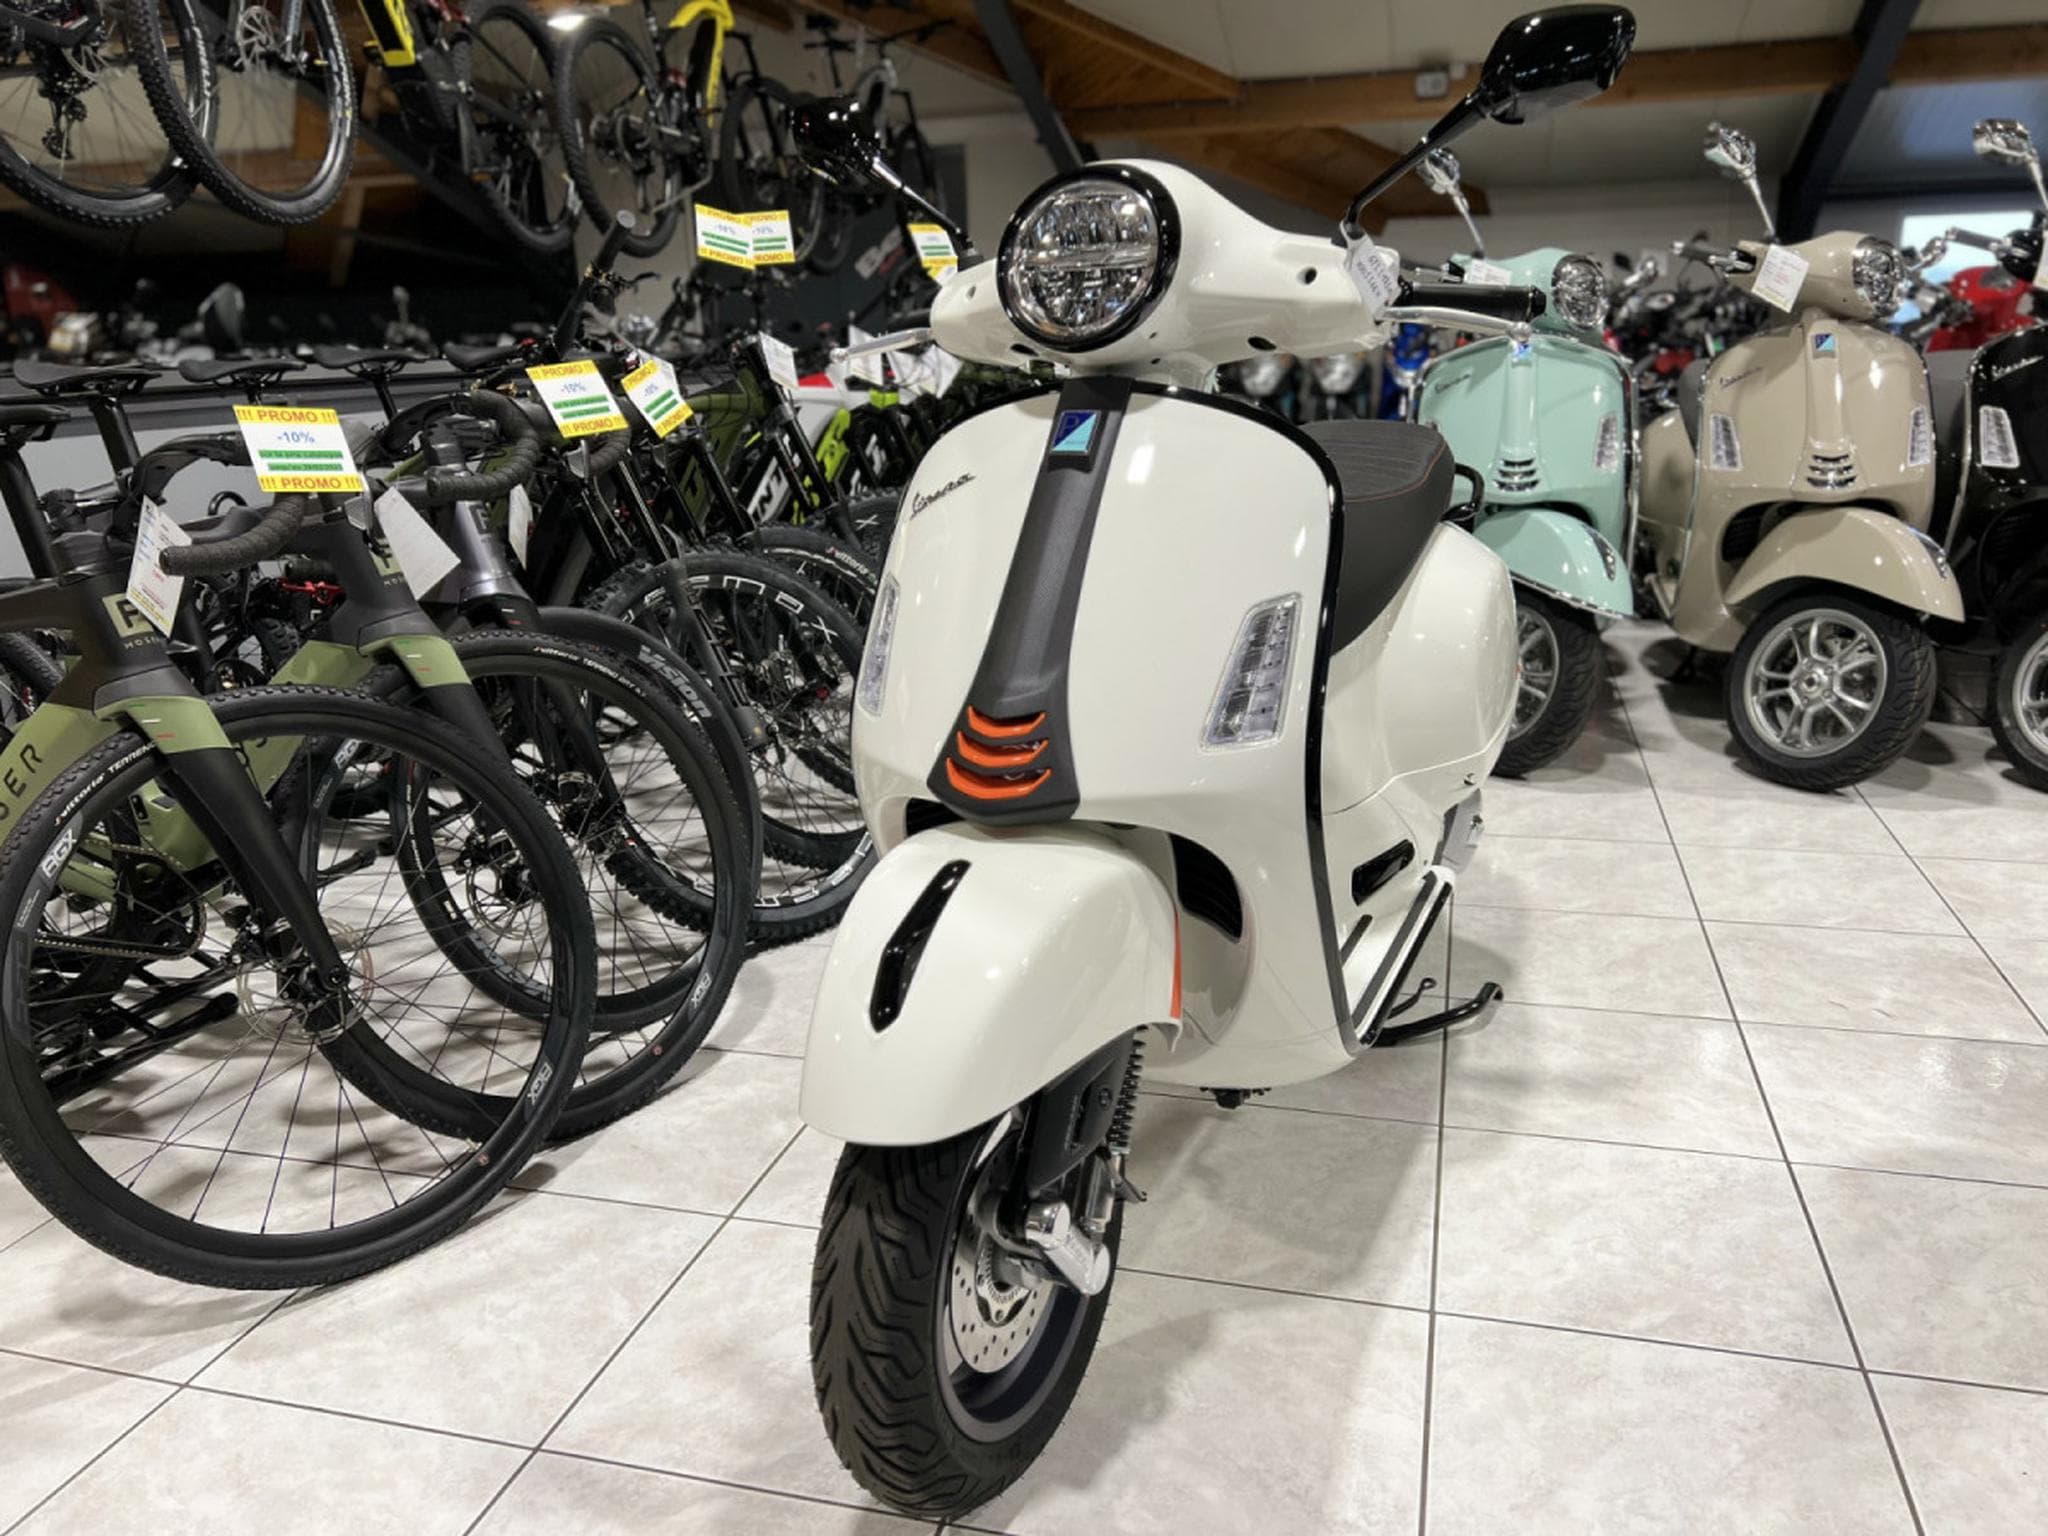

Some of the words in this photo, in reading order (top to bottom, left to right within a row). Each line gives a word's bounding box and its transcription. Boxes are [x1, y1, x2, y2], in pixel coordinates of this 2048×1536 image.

[542, 363, 583, 376] PROMO
[257, 409, 318, 423] PROMO
[573, 417, 614, 431] PROMO
[277, 430, 316, 443] -10%
[281, 476, 342, 489] PROMO
